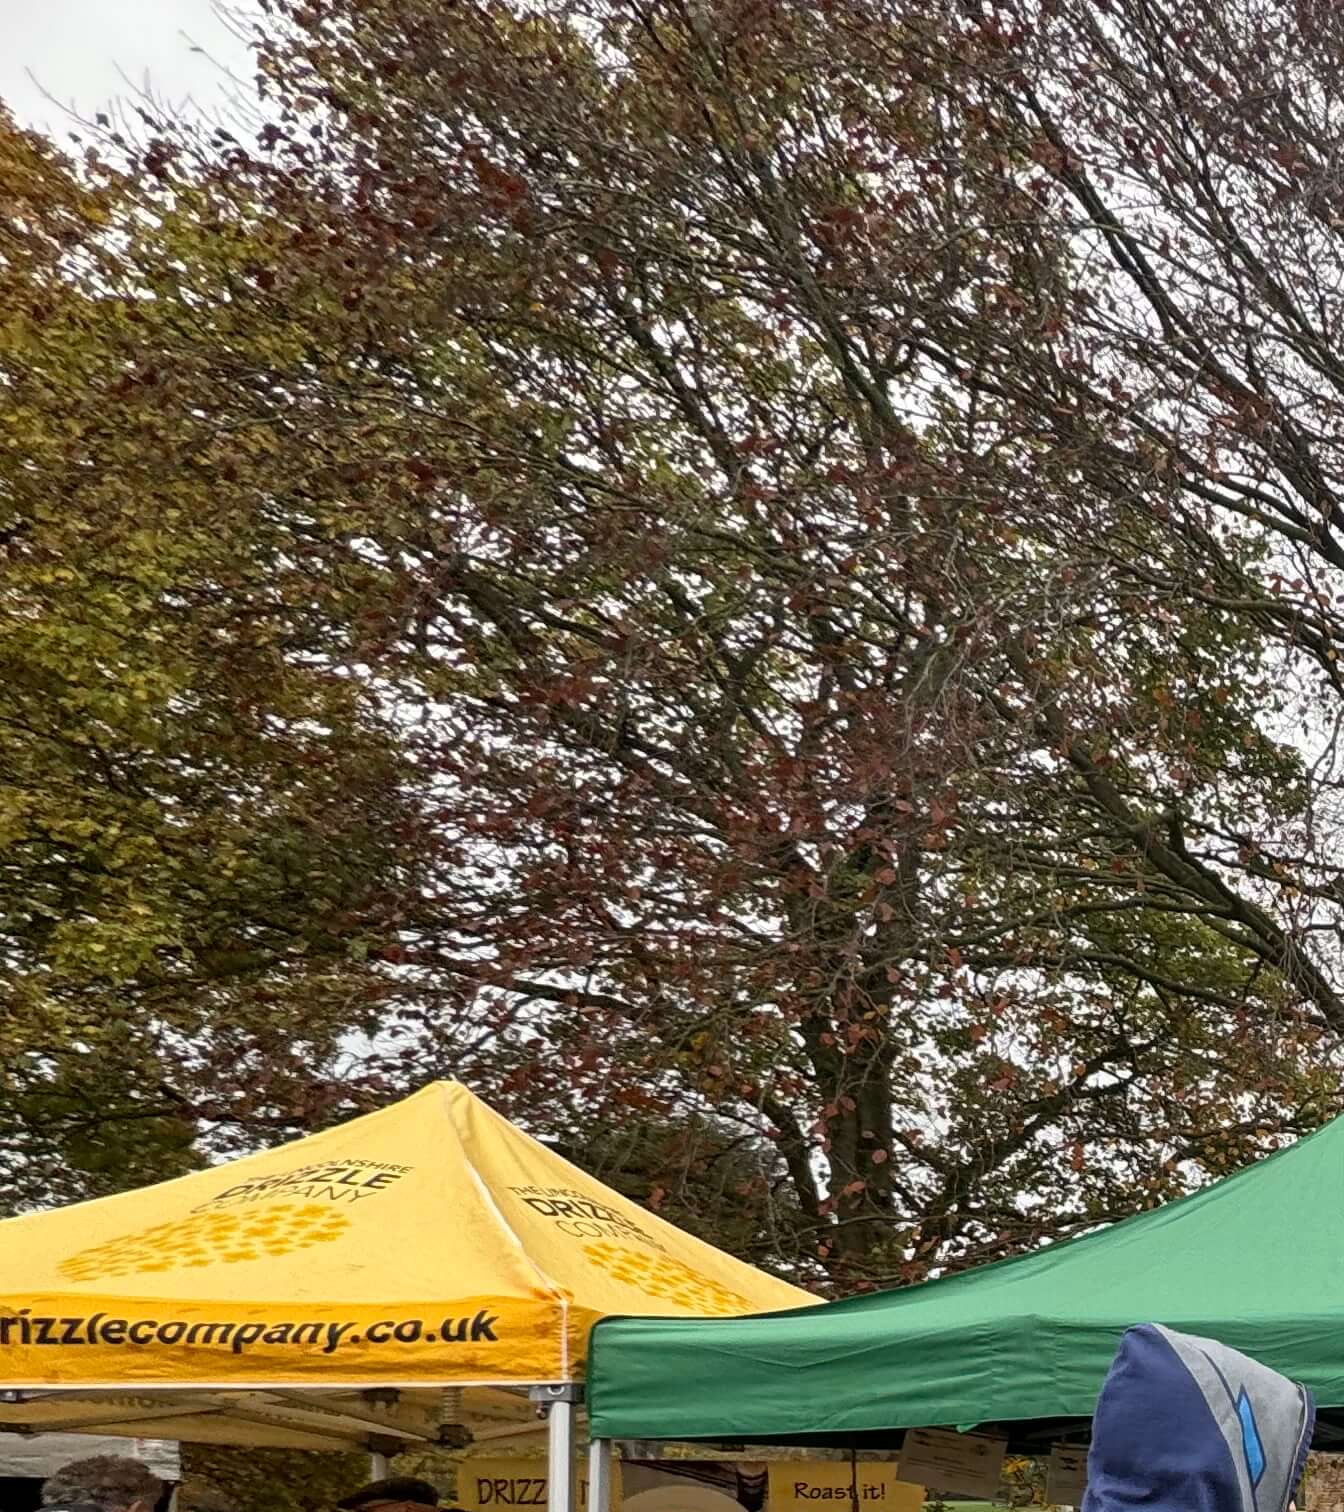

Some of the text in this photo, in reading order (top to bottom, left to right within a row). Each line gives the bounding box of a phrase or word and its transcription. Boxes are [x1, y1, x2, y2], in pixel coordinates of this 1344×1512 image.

[213, 1166, 402, 1201] DRIZZLE
[0, 1308, 500, 1354] rizzlecompany.co.uk
[476, 1478, 549, 1505] DRIZZ
[794, 1482, 886, 1500] Roast it!
